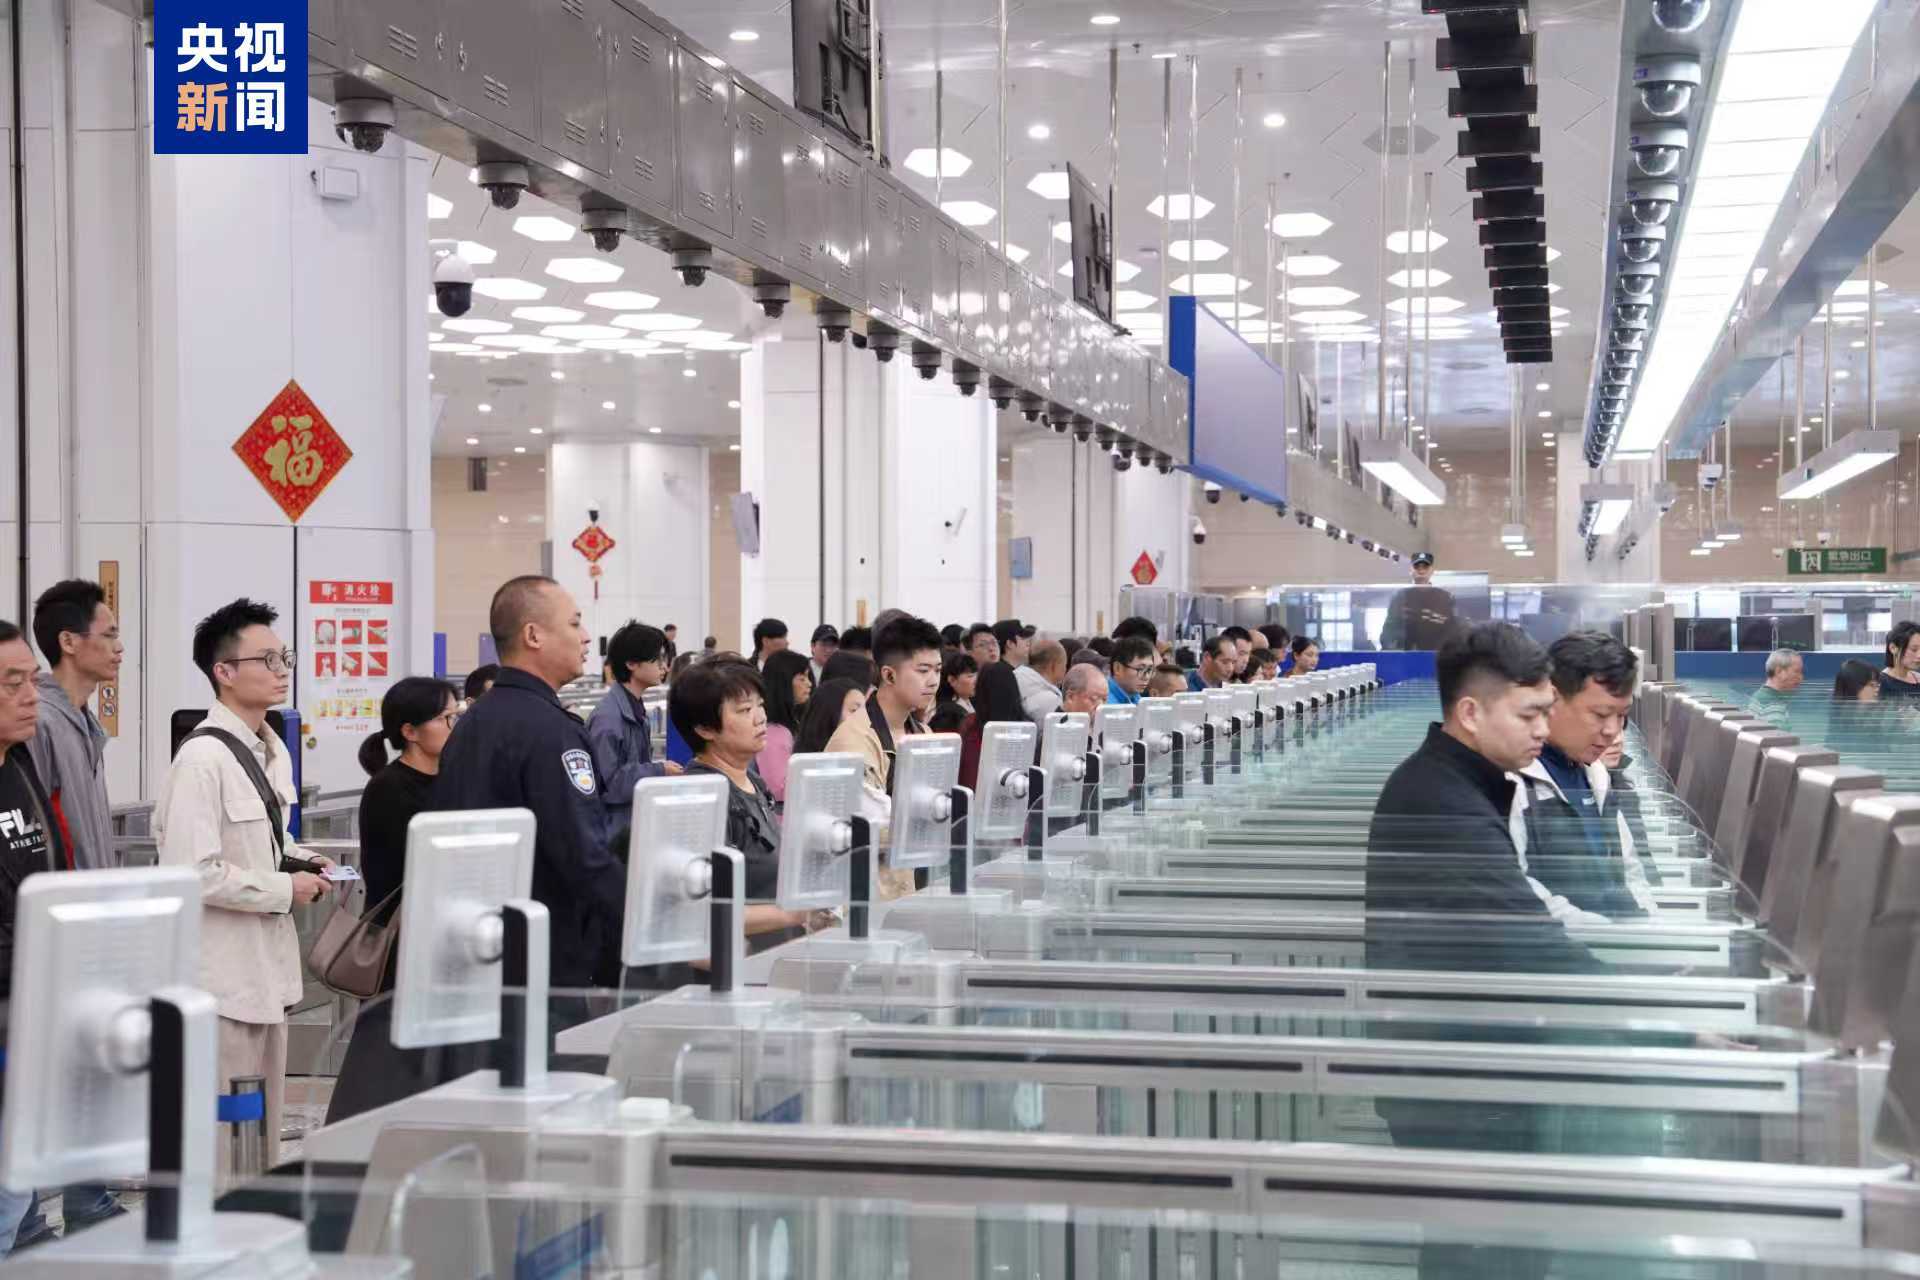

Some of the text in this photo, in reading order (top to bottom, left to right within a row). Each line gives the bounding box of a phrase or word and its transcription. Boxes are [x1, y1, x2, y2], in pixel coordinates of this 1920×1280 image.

[263, 414, 324, 488] 福
[344, 583, 380, 596] 消火栓
